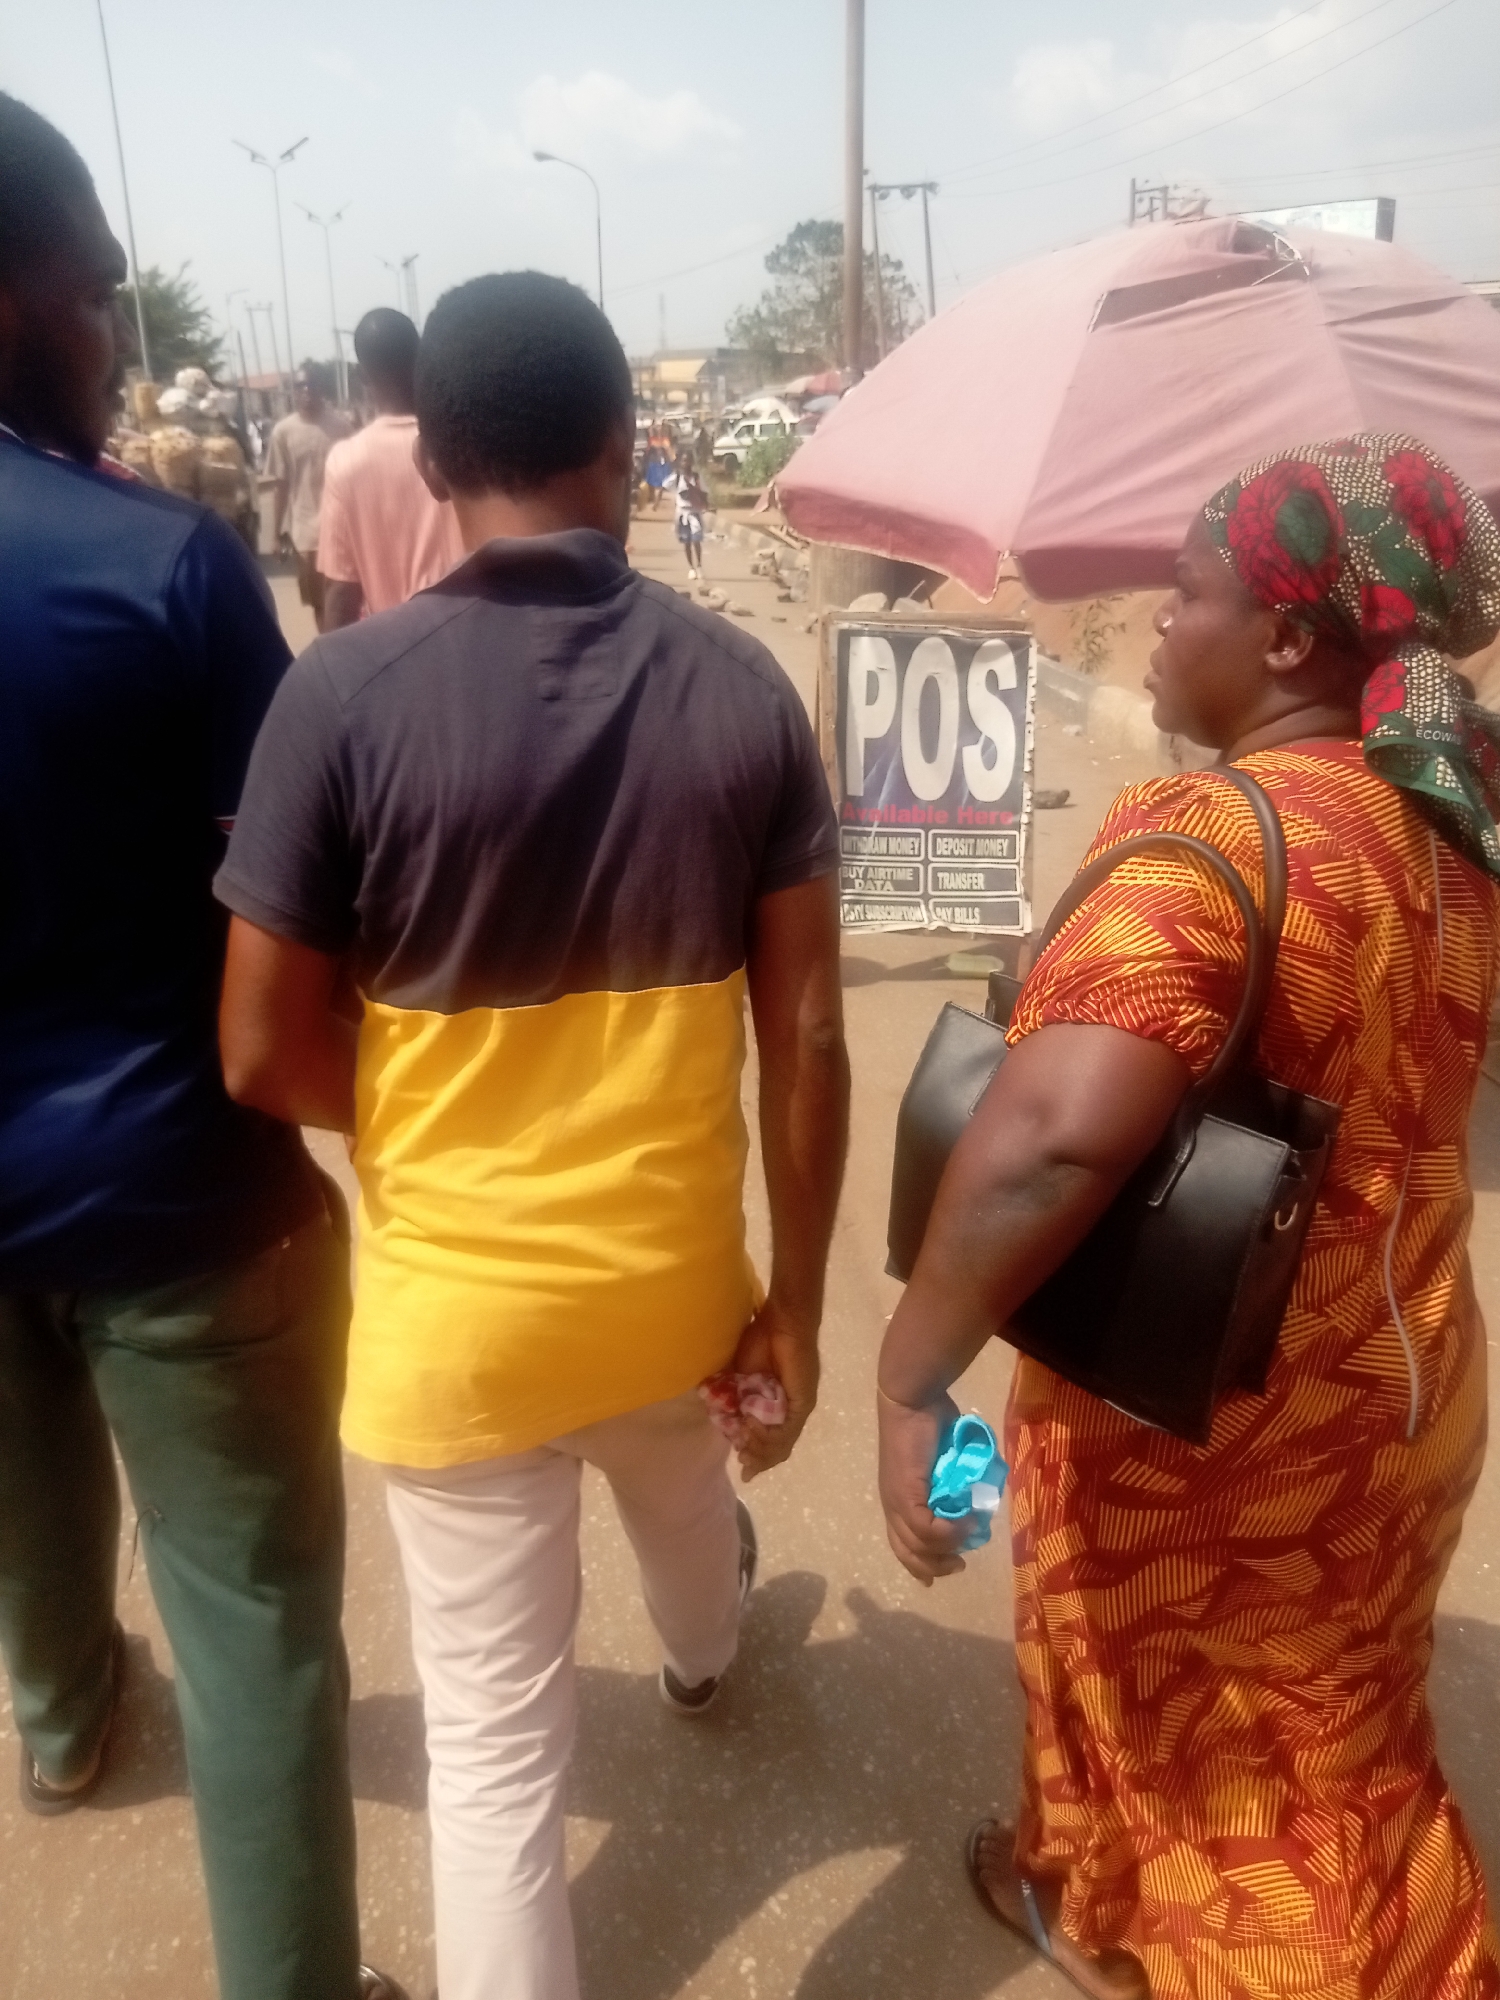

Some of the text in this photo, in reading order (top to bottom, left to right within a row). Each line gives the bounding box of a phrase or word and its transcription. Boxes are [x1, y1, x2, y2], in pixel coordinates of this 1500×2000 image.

[846, 636, 1017, 803] POS
[842, 803, 1013, 825] Available Here
[888, 837, 920, 856] MONEY
[936, 837, 1009, 857] DEPOSIT MONEY
[842, 866, 914, 881] BUY AIRTIME
[937, 872, 985, 890] TRANSFER
[854, 878, 894, 892] DATA
[954, 906, 980, 924] BILLS
